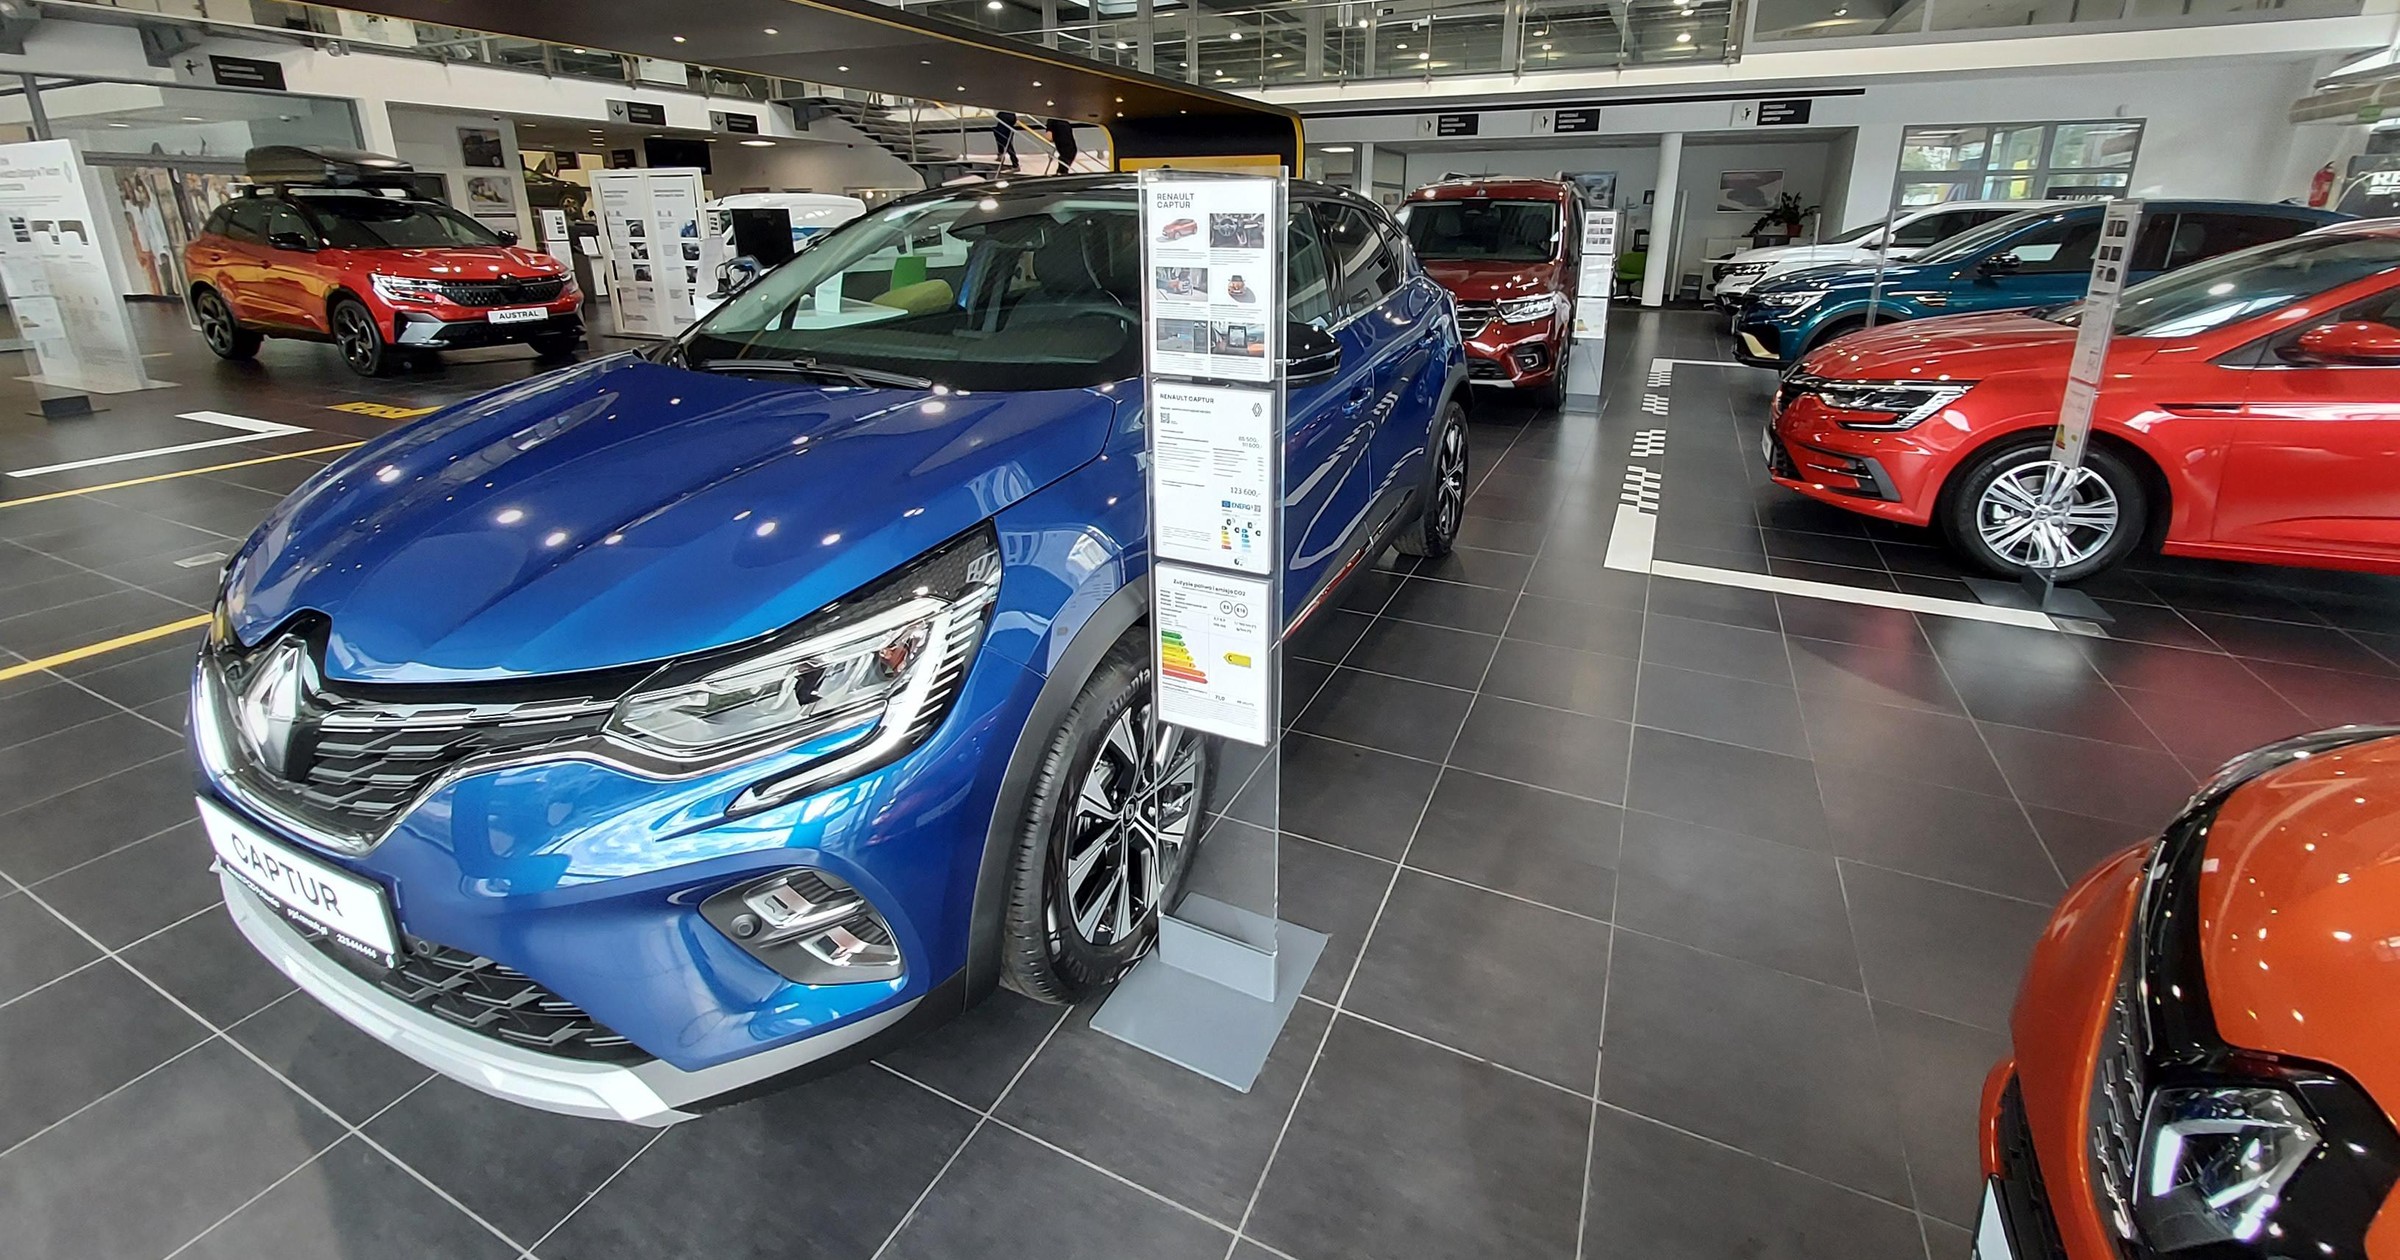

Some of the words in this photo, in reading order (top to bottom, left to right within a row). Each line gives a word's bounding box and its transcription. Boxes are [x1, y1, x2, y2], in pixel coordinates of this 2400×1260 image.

[499, 311, 539, 319] AUSTRAL
[1160, 393, 1187, 401] RENAULT
[232, 833, 343, 917] CAPTUR
